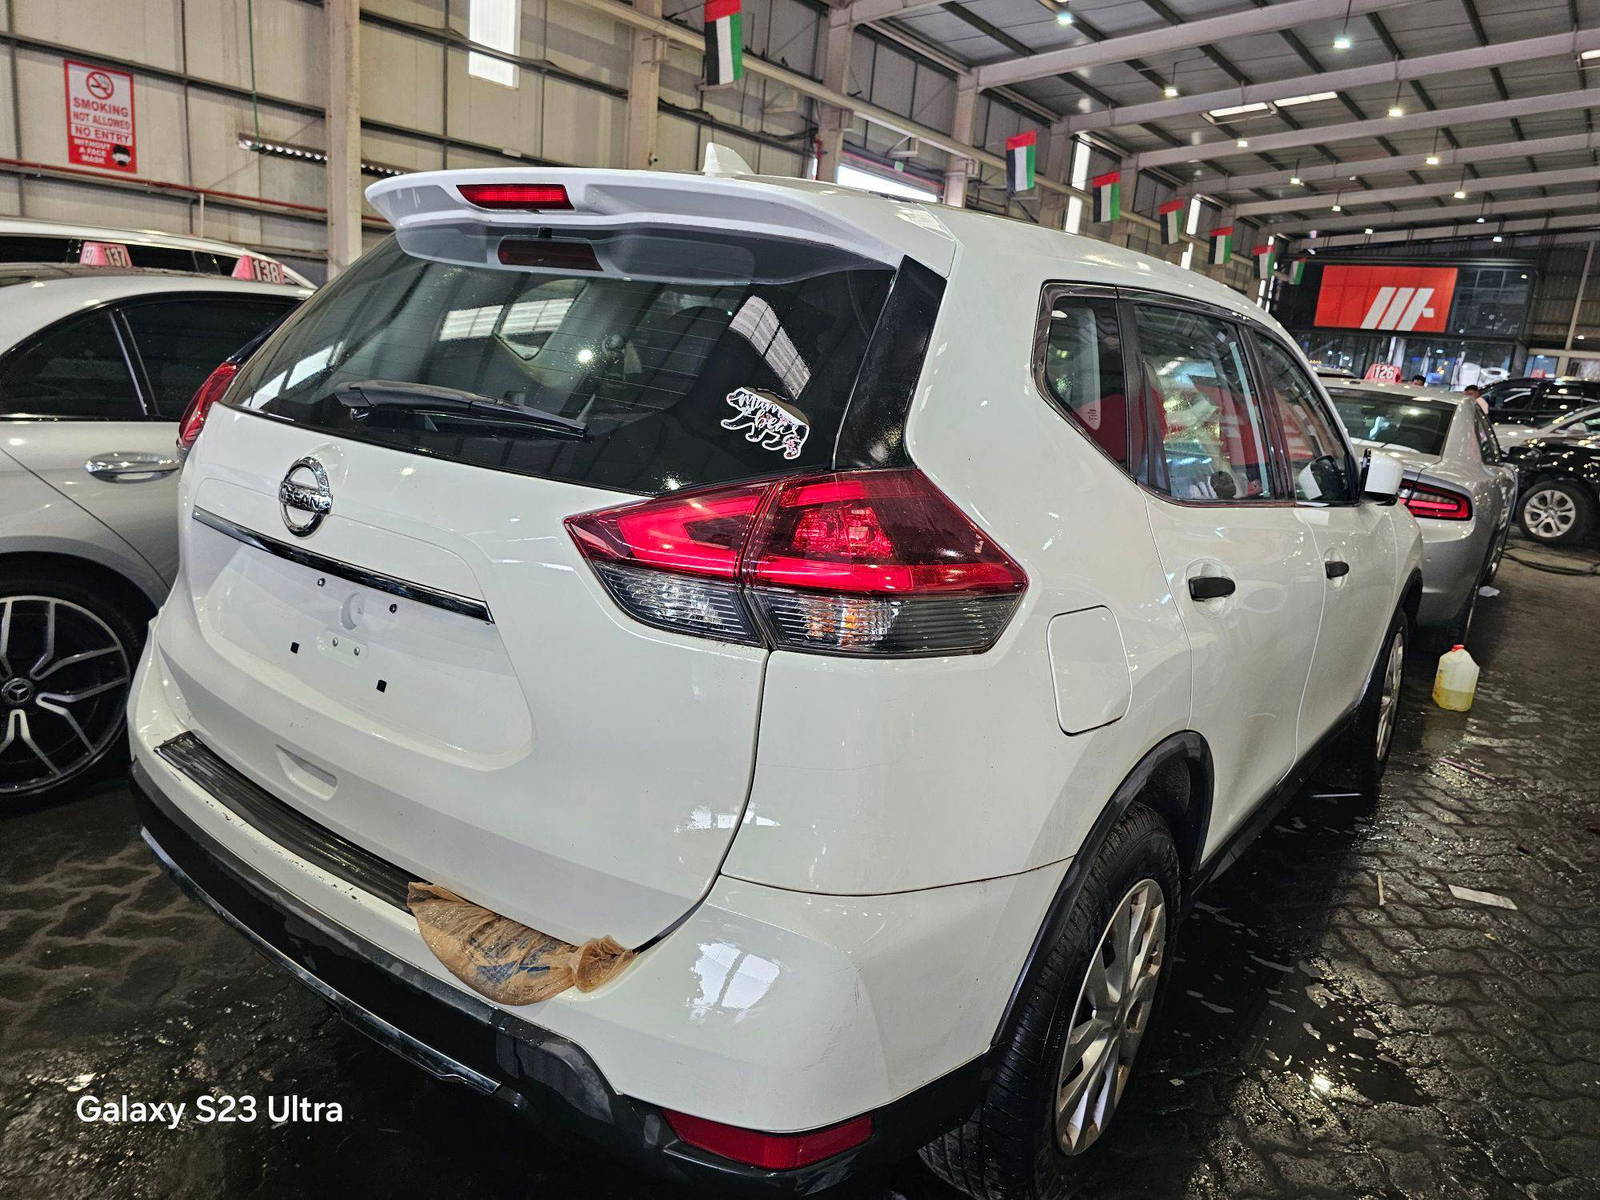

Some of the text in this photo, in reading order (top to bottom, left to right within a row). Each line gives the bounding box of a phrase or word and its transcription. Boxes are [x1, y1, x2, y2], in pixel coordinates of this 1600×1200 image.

[73, 97, 129, 118] SMOKING
[73, 111, 130, 130] NOT ALLOWED
[74, 138, 111, 151] WITHOUT
[75, 126, 130, 144] NO ENTRY
[105, 247, 127, 267] 137
[253, 259, 281, 284] 138
[1374, 366, 1395, 379] 126
